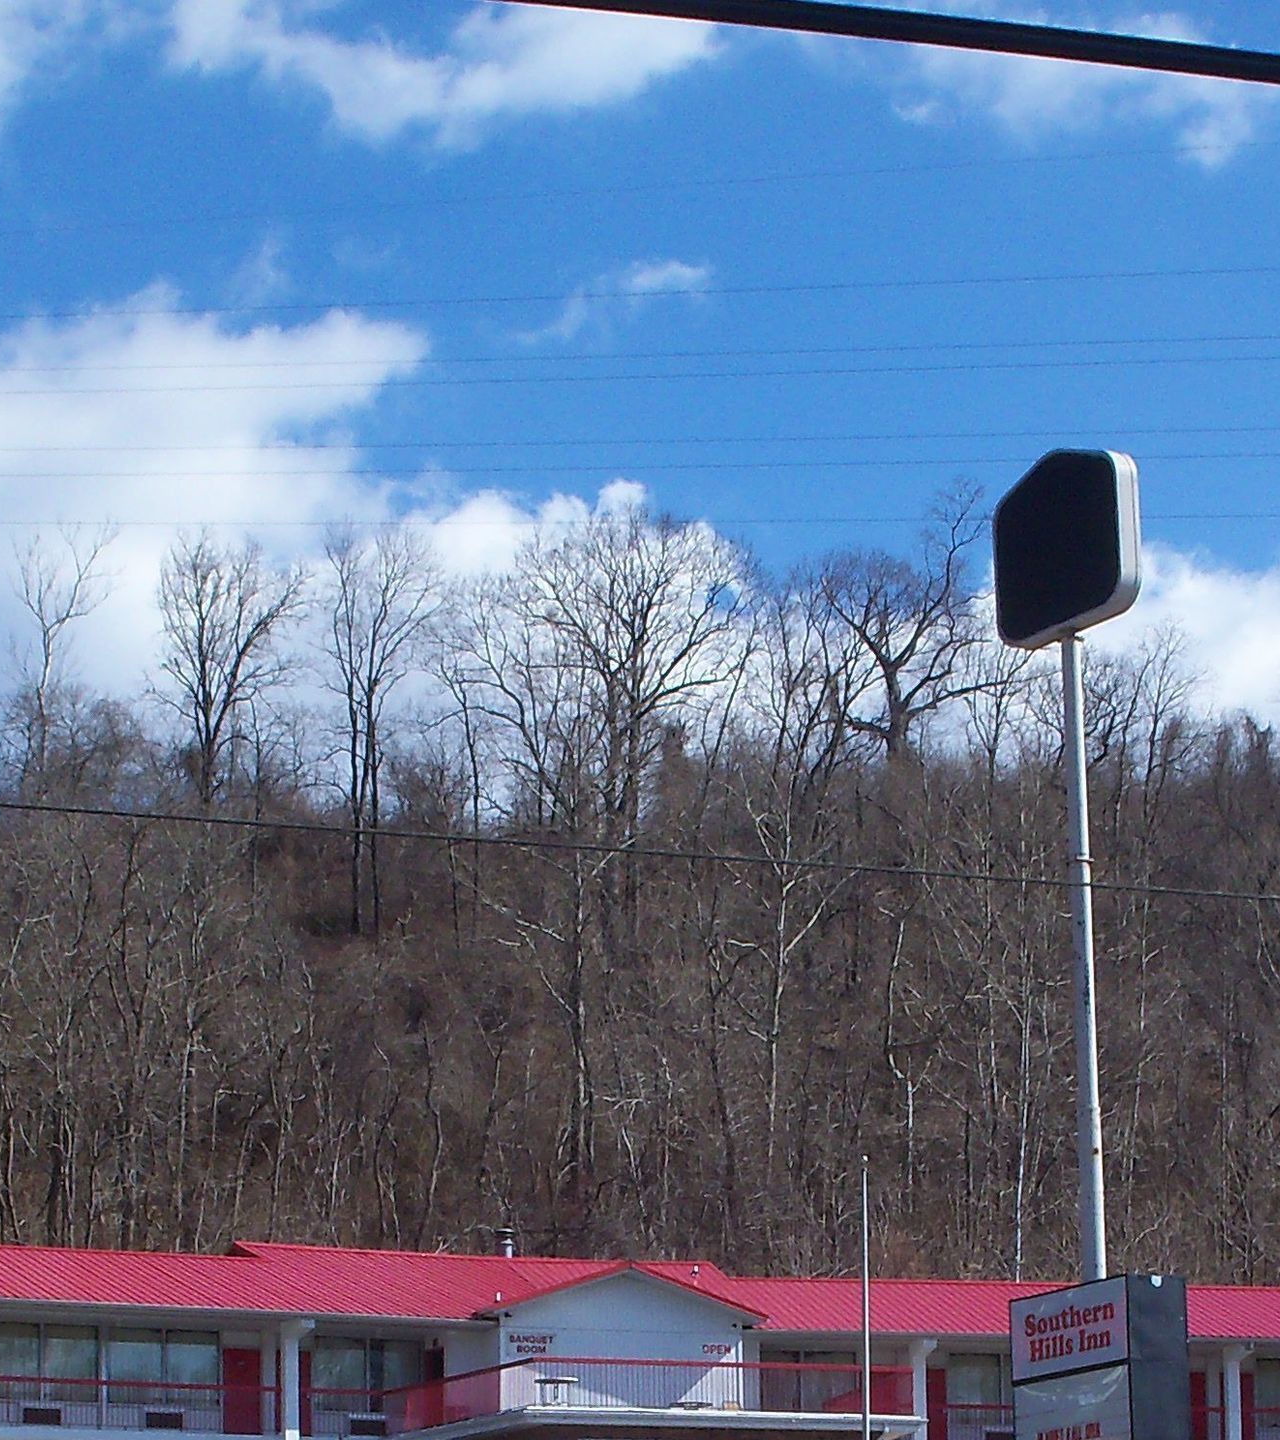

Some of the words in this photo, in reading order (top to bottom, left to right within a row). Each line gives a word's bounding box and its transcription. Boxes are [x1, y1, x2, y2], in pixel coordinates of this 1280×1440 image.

[1024, 1302, 1115, 1337] Southern
[509, 1334, 554, 1344] BANQUET
[516, 1344, 547, 1354] ROOM
[702, 1344, 731, 1354] OPEN
[1029, 1333, 1074, 1362] Hills
[1078, 1328, 1111, 1352] Inn
